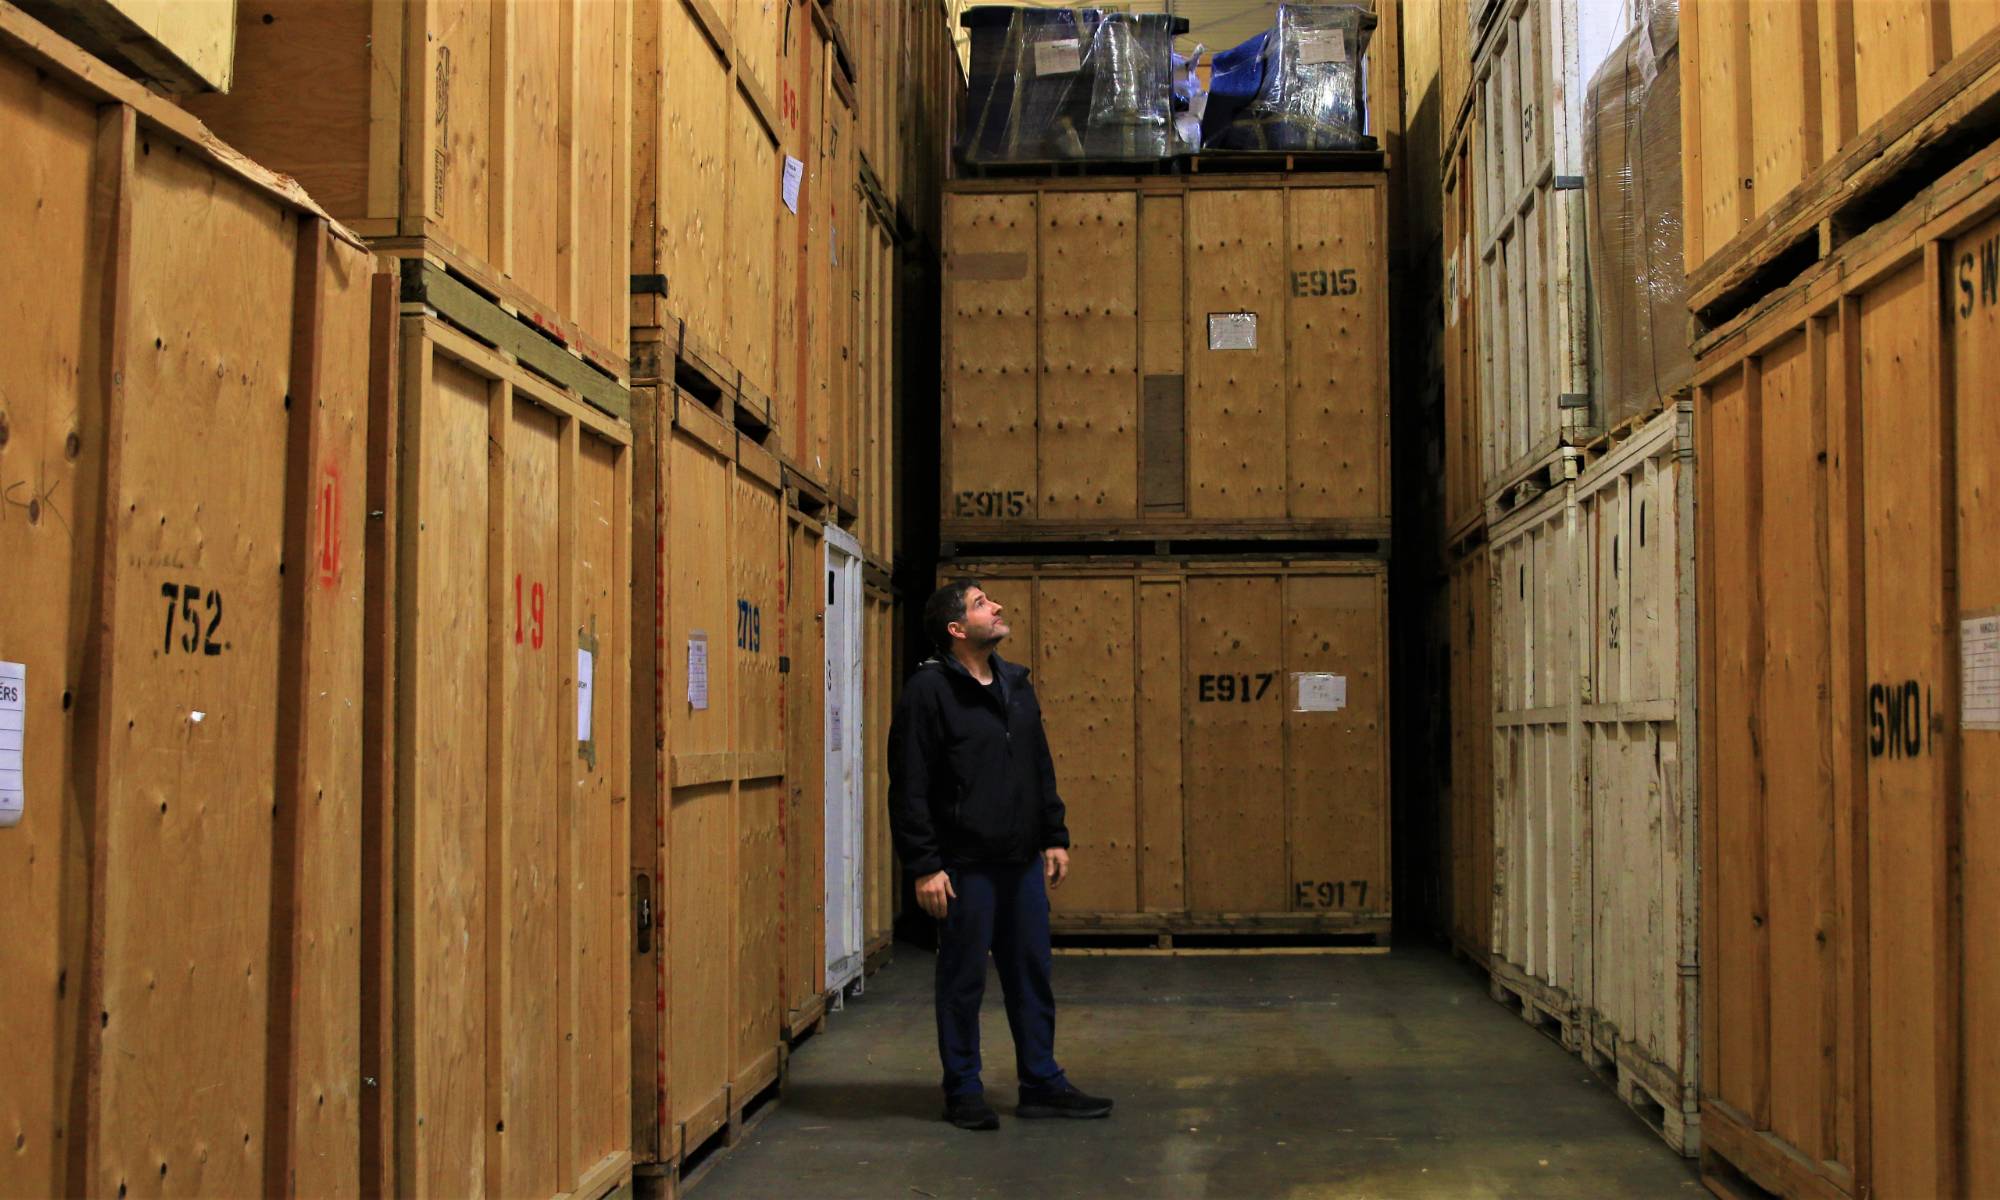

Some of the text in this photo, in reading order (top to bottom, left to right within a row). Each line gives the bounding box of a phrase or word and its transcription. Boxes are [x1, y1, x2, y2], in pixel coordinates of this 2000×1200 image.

[1291, 268, 1358, 298] E915
[955, 490, 1024, 517] E915
[161, 582, 222, 656] 752
[515, 572, 545, 650] 19
[1199, 672, 1273, 703] E917
[1295, 880, 1367, 907] E917
